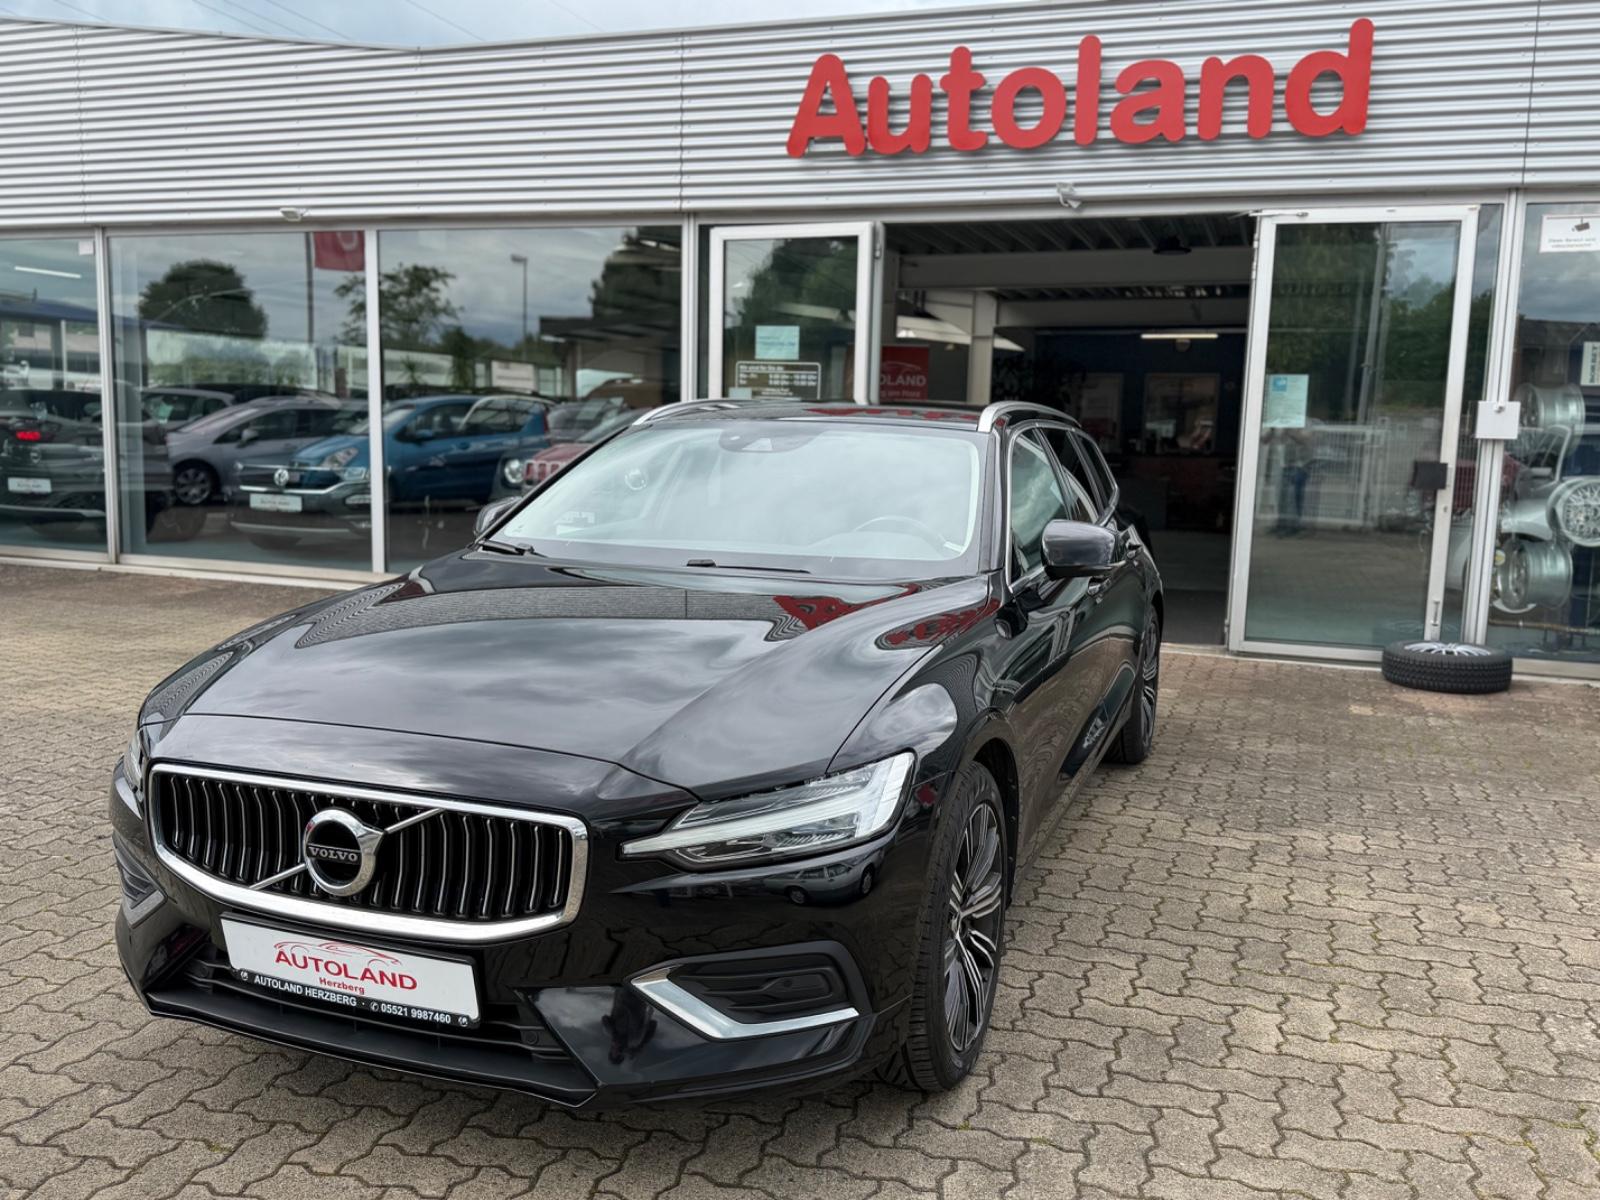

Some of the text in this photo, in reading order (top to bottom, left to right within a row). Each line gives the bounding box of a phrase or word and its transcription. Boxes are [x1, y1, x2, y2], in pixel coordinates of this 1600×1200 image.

[786, 18, 1375, 158] Autoland
[880, 374, 927, 387] OLAND
[308, 846, 358, 861] VOLVO
[275, 950, 418, 990] AUTOLAND
[254, 975, 451, 1024] AUTOLAND HERZBERG 05521 9987460
[319, 977, 365, 995] Herzberg
